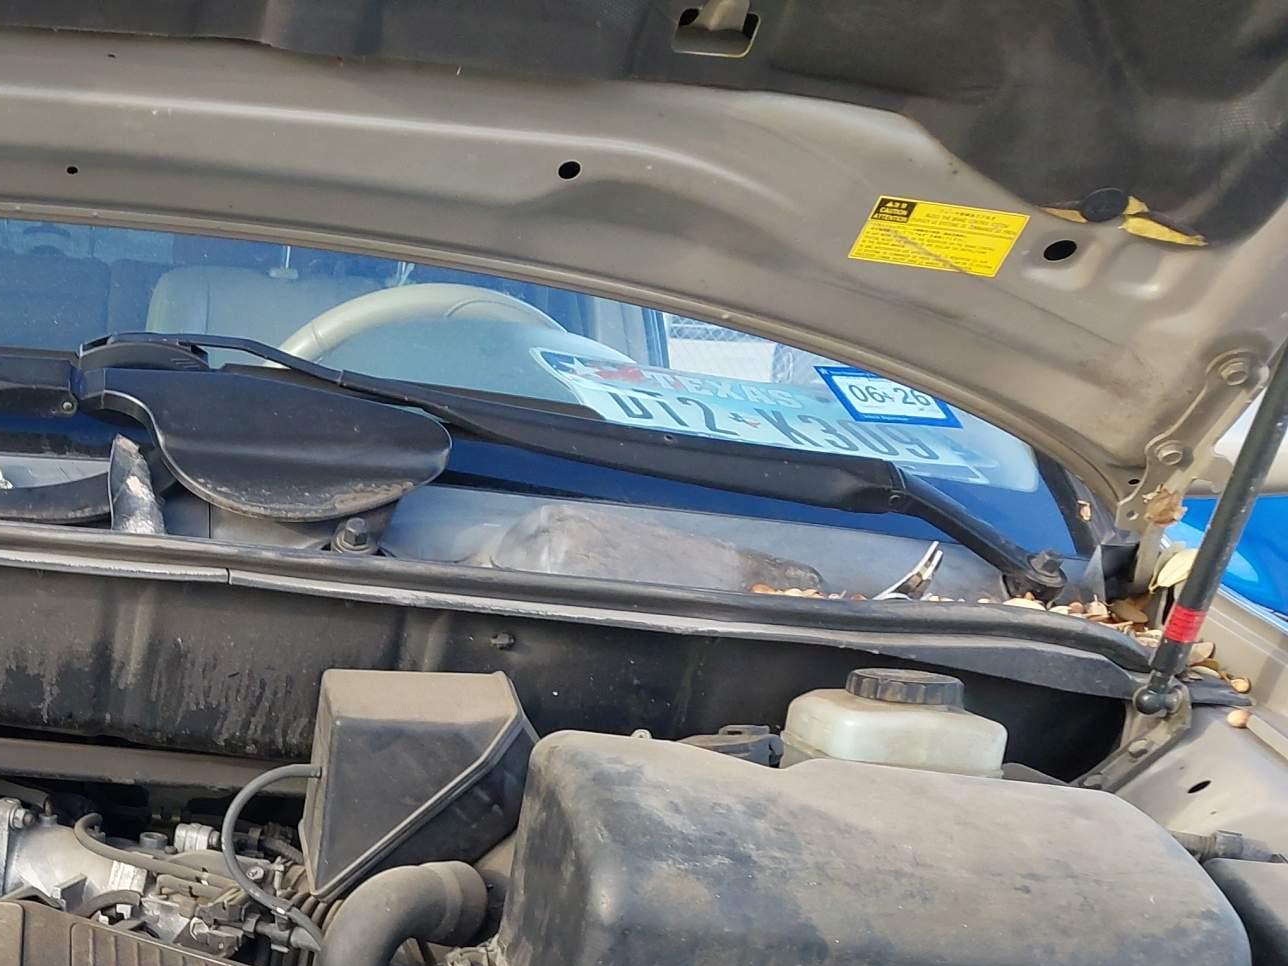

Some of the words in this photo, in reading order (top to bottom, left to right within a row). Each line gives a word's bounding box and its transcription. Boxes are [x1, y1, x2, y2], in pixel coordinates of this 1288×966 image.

[643, 370, 805, 411] TEXAS
[848, 383, 887, 405] 06
[893, 386, 932, 407] 26
